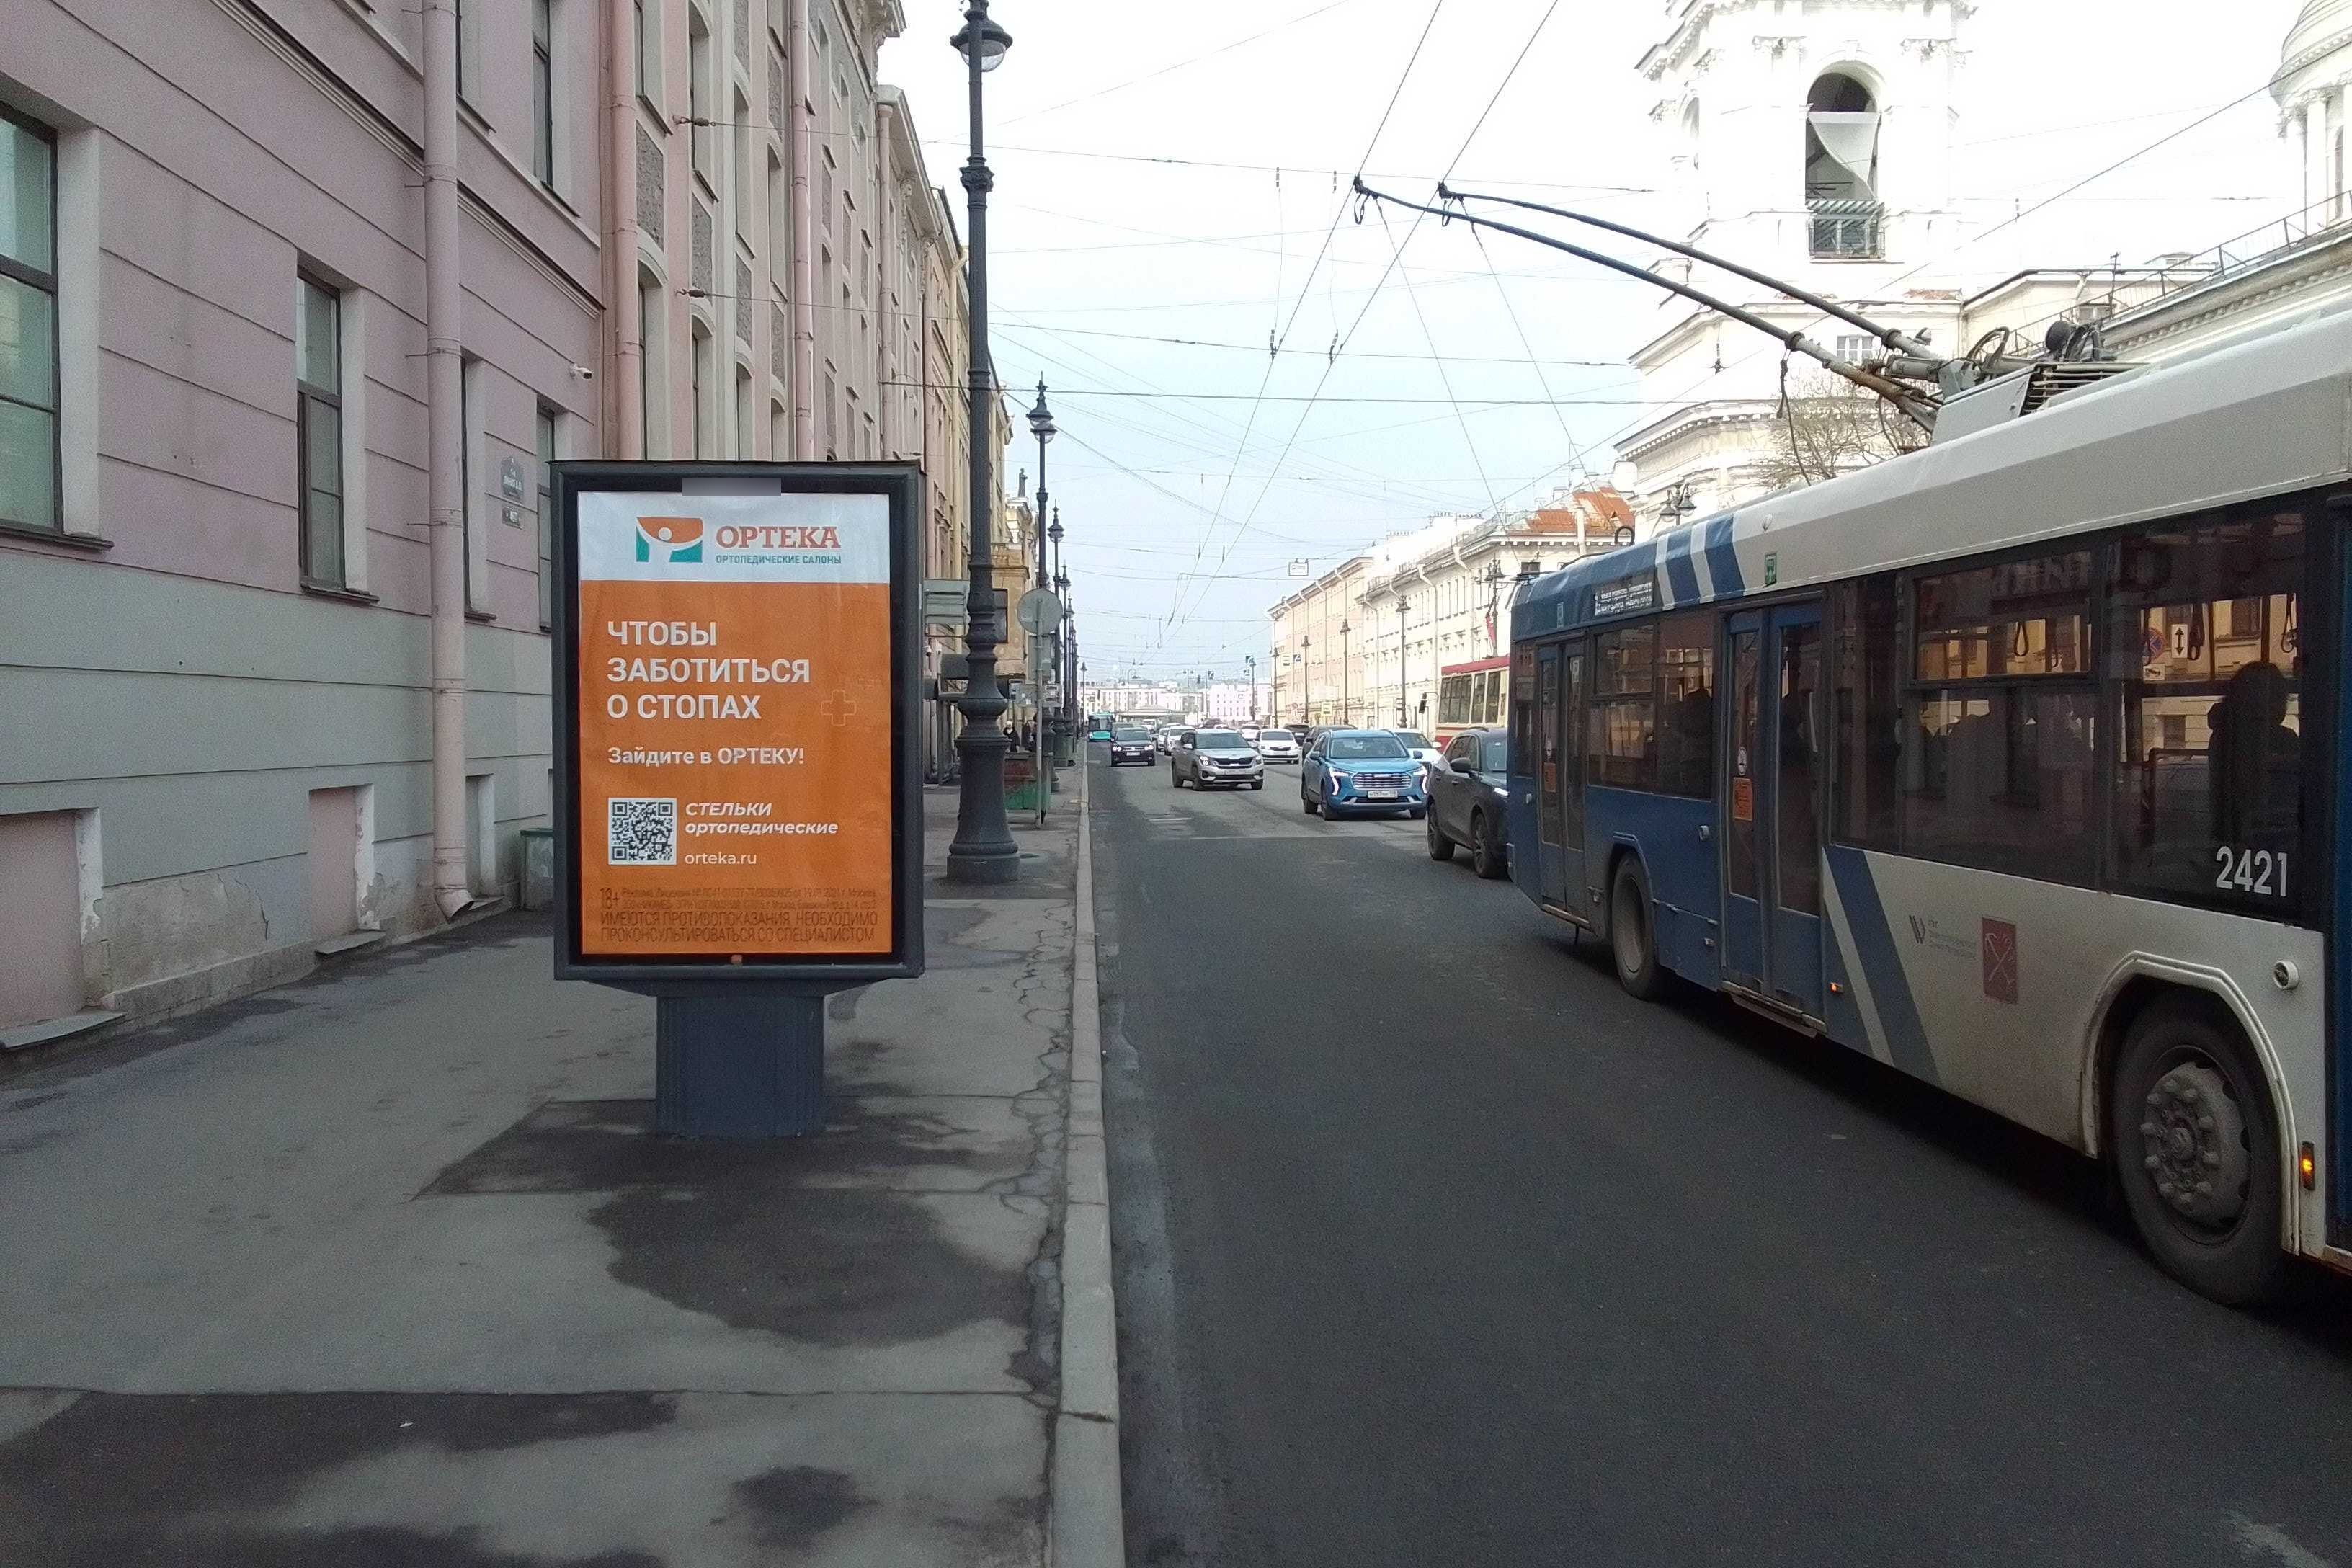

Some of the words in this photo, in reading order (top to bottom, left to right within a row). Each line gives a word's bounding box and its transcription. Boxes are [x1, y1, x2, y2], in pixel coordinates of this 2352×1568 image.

[716, 525, 842, 549] ОРТЕКА
[716, 555, 801, 565] ОРТОПЕДИЧЕСКИЕ
[803, 555, 842, 564] САЛОНЫ
[608, 621, 716, 646] ЧТОБЫ
[607, 658, 810, 682] ЗАБОТИТЬСЯ
[607, 695, 628, 718] О
[637, 695, 761, 719] СТОПАХ
[608, 747, 695, 767] Зайдите
[700, 752, 712, 763] в
[718, 747, 805, 765] ОРТЕКУ!
[685, 802, 772, 816] СТЕЛЬКИ
[685, 822, 839, 836] ортопедические
[685, 852, 757, 865] orteka.ru
[2216, 846, 2288, 896] 2421
[796, 910, 879, 927] НЕОБХОДИМО
